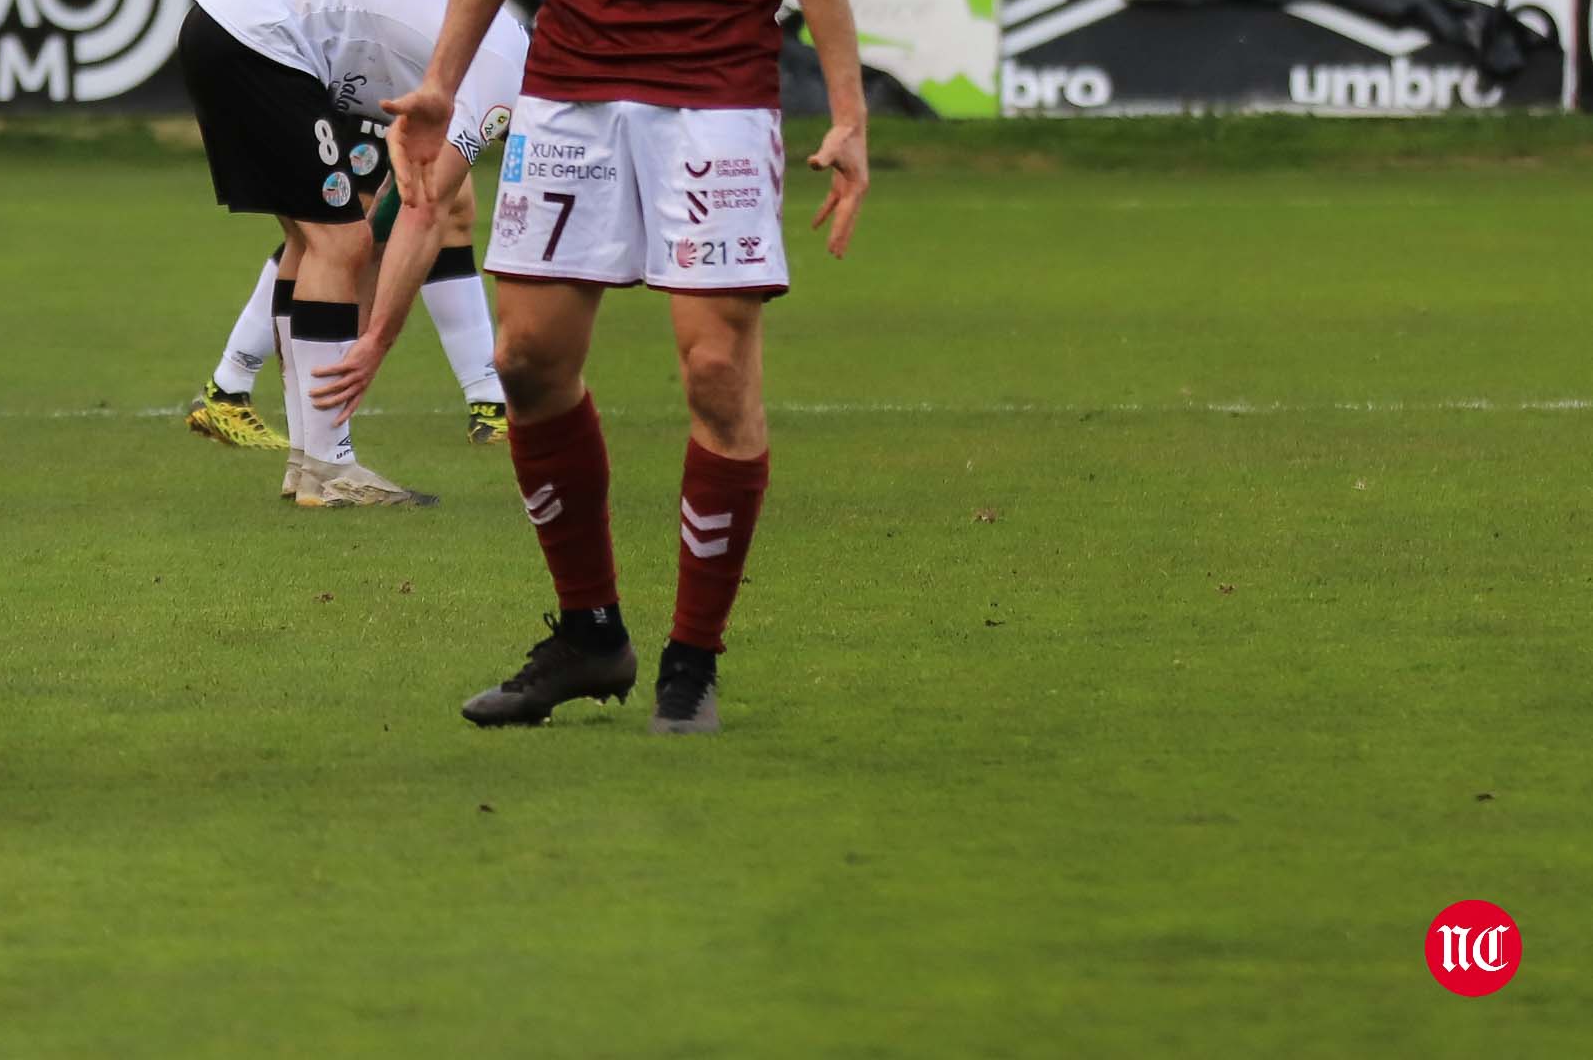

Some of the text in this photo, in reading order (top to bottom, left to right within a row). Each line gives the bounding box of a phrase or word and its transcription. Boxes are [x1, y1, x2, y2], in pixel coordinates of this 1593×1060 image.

[1289, 56, 1503, 109] umbro
[314, 119, 339, 166] 8
[530, 143, 586, 159] XUNTA
[527, 162, 617, 180] DE GALICIA
[542, 191, 576, 262] 7
[701, 241, 727, 266] 21
